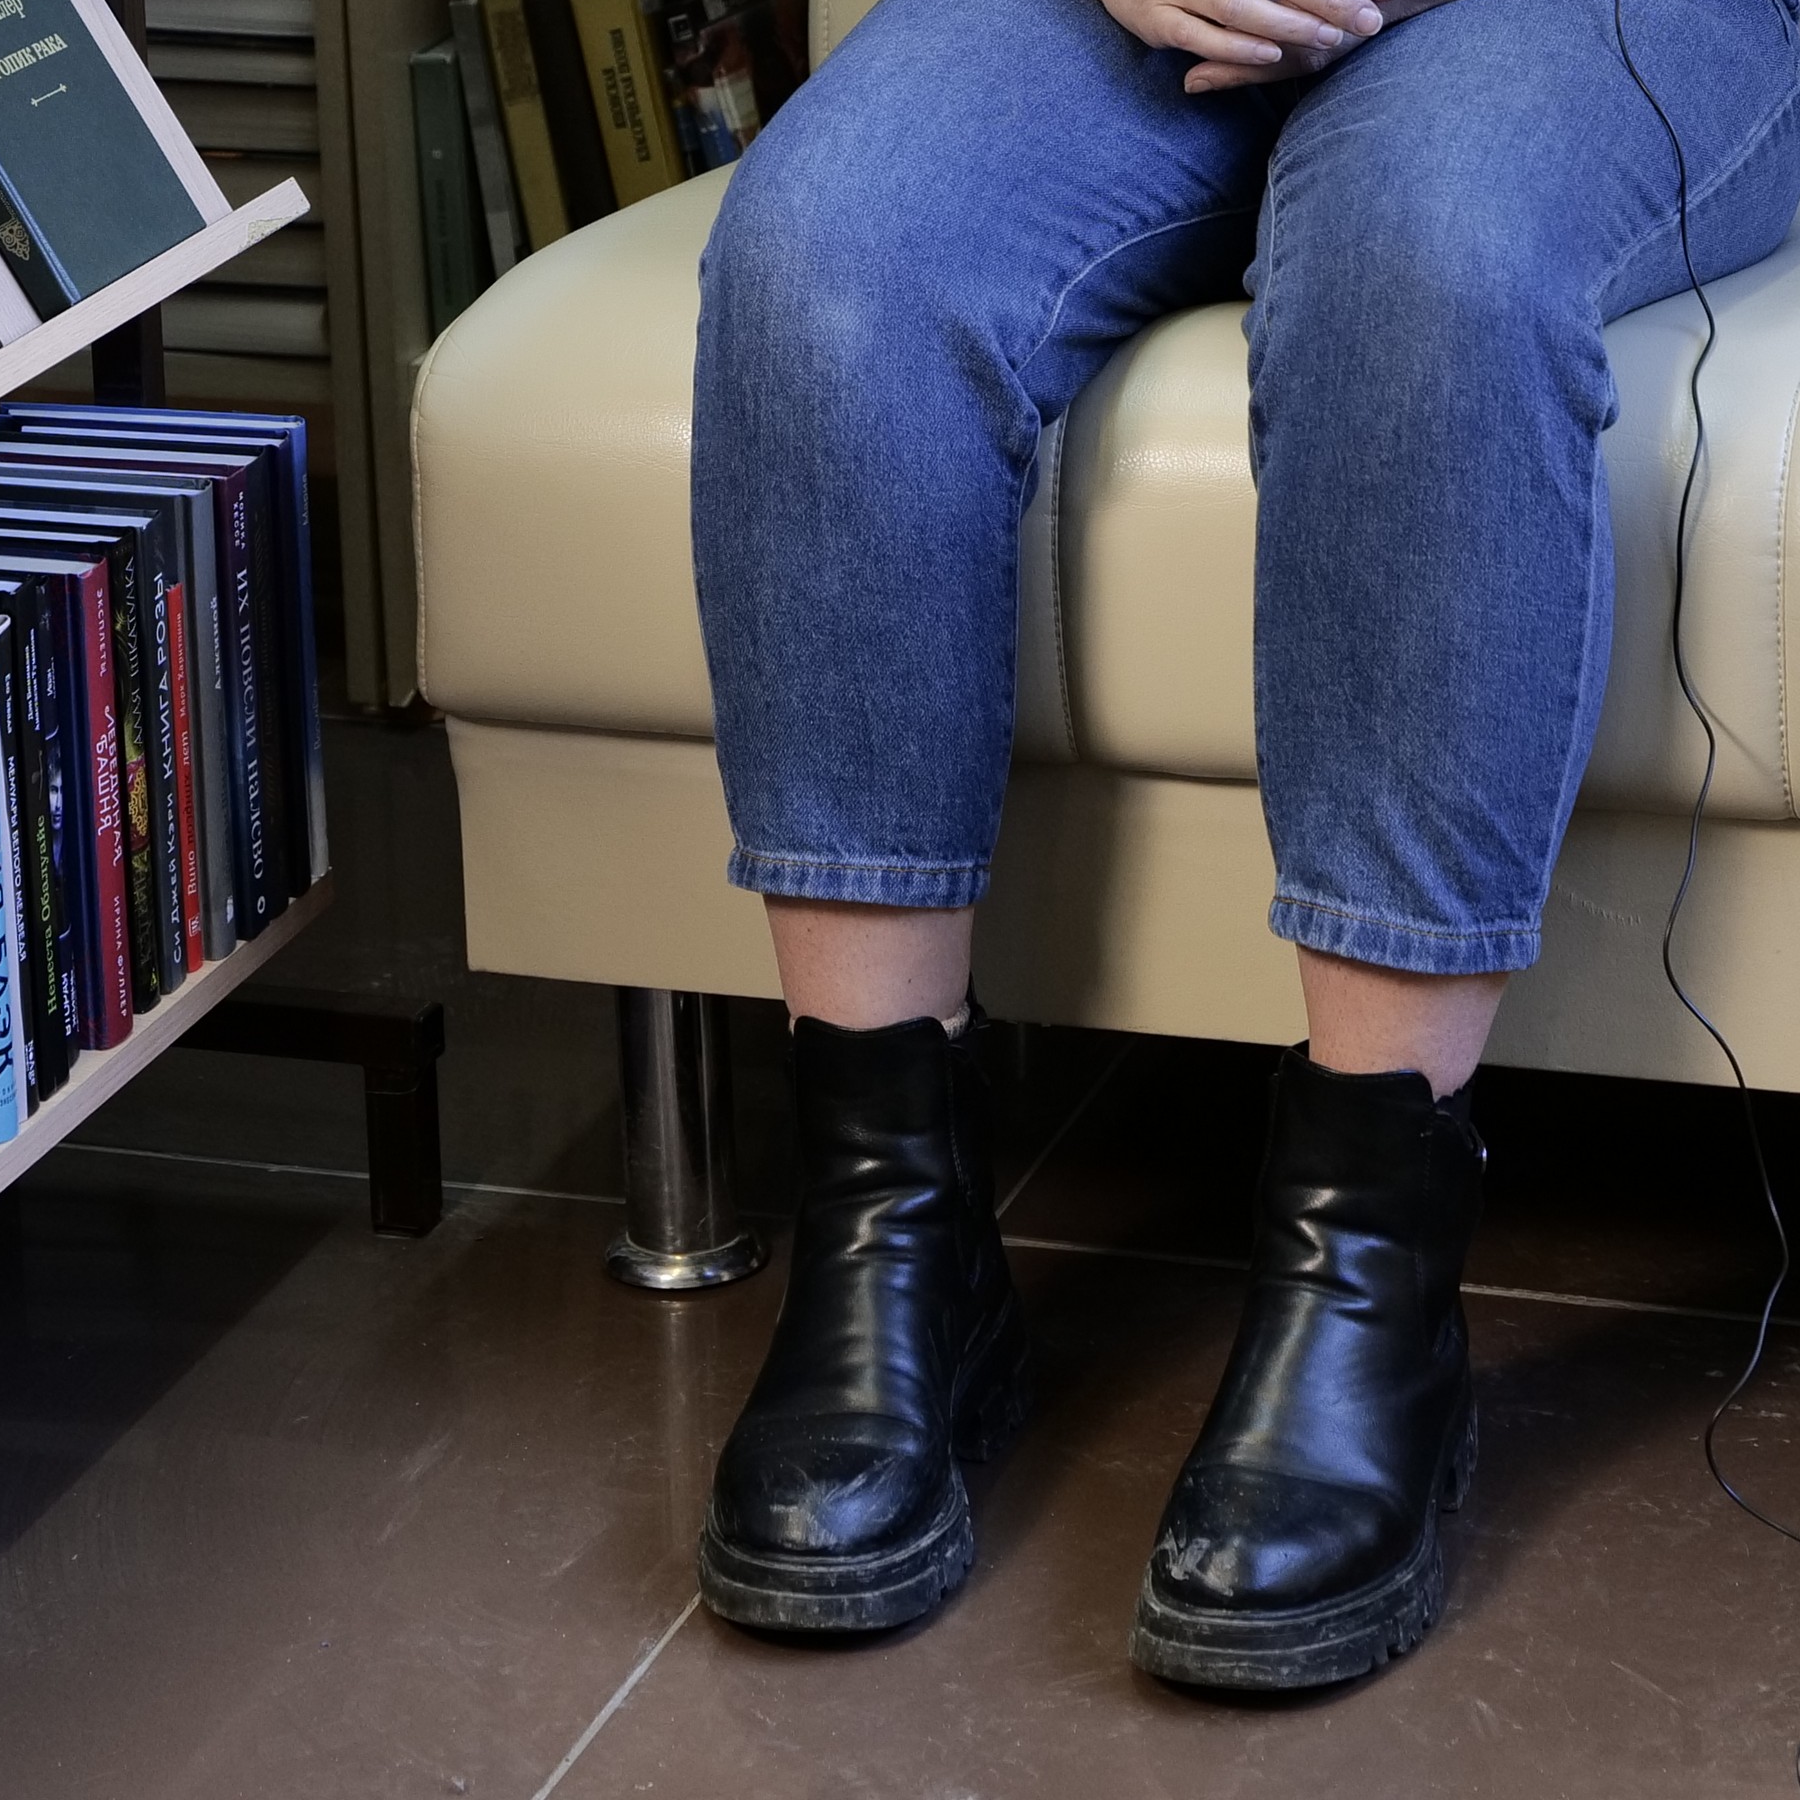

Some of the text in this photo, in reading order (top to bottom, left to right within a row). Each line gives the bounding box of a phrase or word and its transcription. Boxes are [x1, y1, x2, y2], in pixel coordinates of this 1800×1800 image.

[20, 33, 69, 65] РАКА
[235, 566, 248, 617] ИХ
[152, 570, 175, 781] КНИГА РОЗЫ
[95, 730, 113, 838] БАШНЯ
[103, 705, 125, 868] ЛЕБЕДИНАЯ
[6, 755, 27, 963] МЕМУАРЫ БЕЛОГО МЕДВЕДЯ
[45, 919, 59, 1016] Невеста
[112, 894, 129, 1019] ИРИНА ФУЛЛЕР
